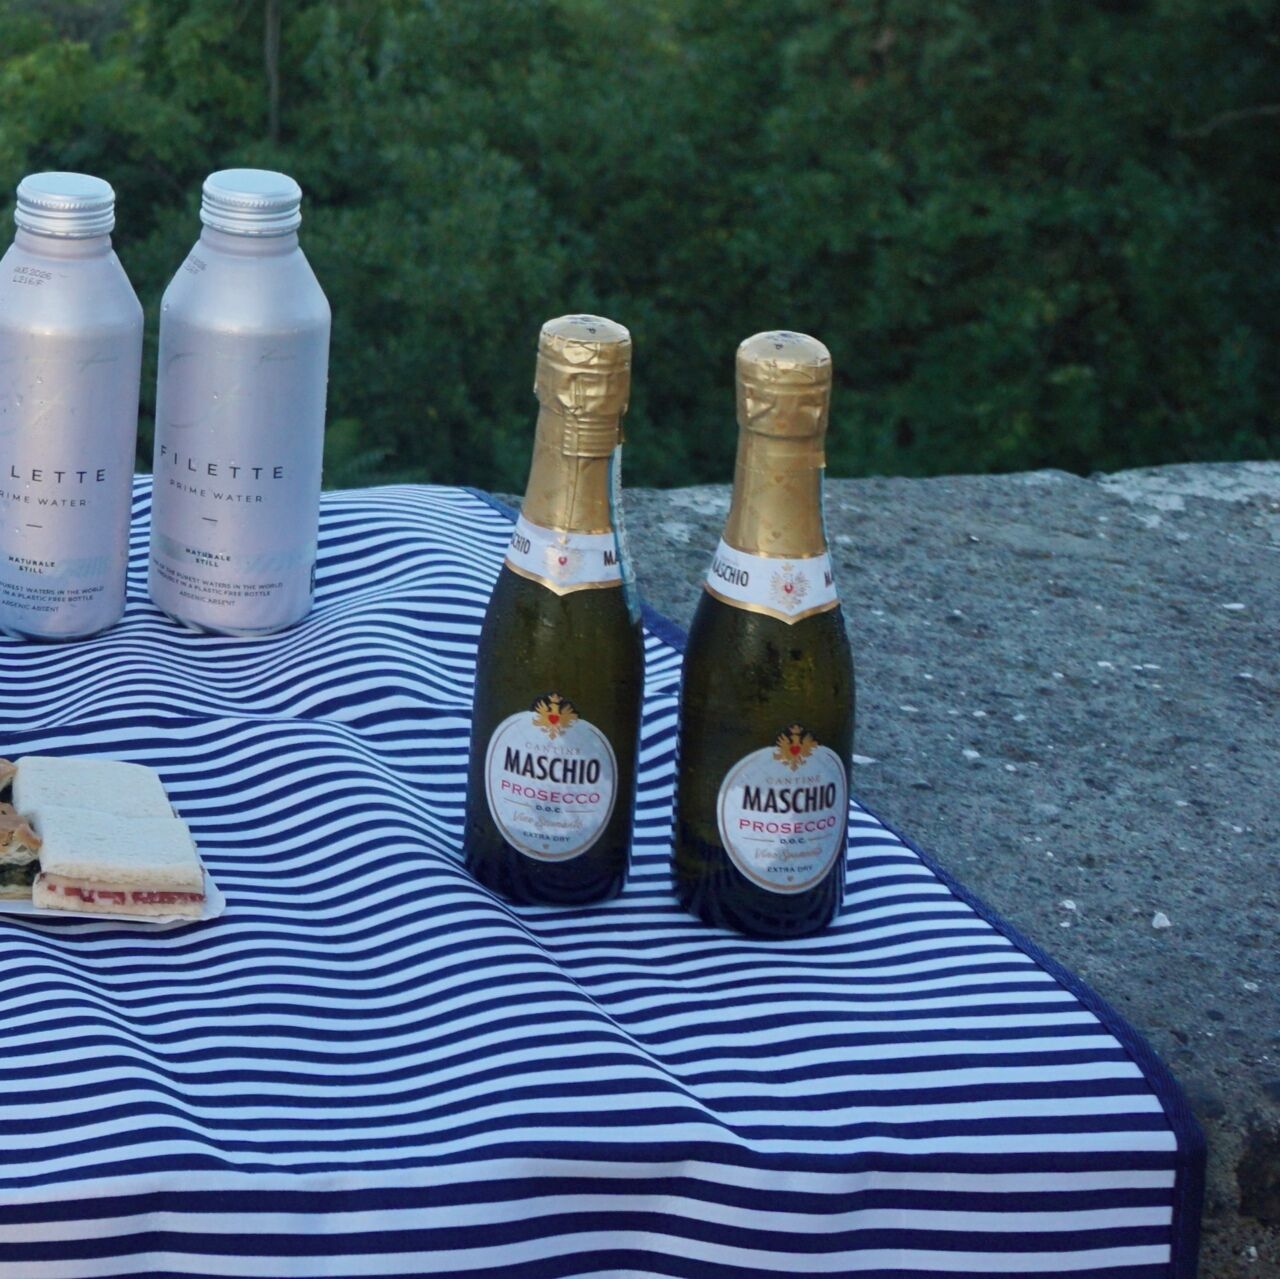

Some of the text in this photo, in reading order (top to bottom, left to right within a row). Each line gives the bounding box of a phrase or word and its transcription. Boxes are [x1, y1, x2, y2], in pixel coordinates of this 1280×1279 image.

[160, 444, 284, 480] FILETTE
[170, 479, 263, 503] PRIME WATER
[38, 498, 86, 507] WATER
[8, 556, 56, 567] NATURALE
[186, 548, 231, 562] NATURALE
[19, 565, 43, 574] STILL
[195, 558, 219, 568] STILL
[503, 746, 600, 785] MASCHIO
[766, 775, 821, 785] CANTINE
[501, 779, 600, 804] PROSECCO
[742, 781, 836, 814] MASCHIO
[739, 816, 836, 834] PROSECCO
[523, 831, 551, 841] EXTRA
